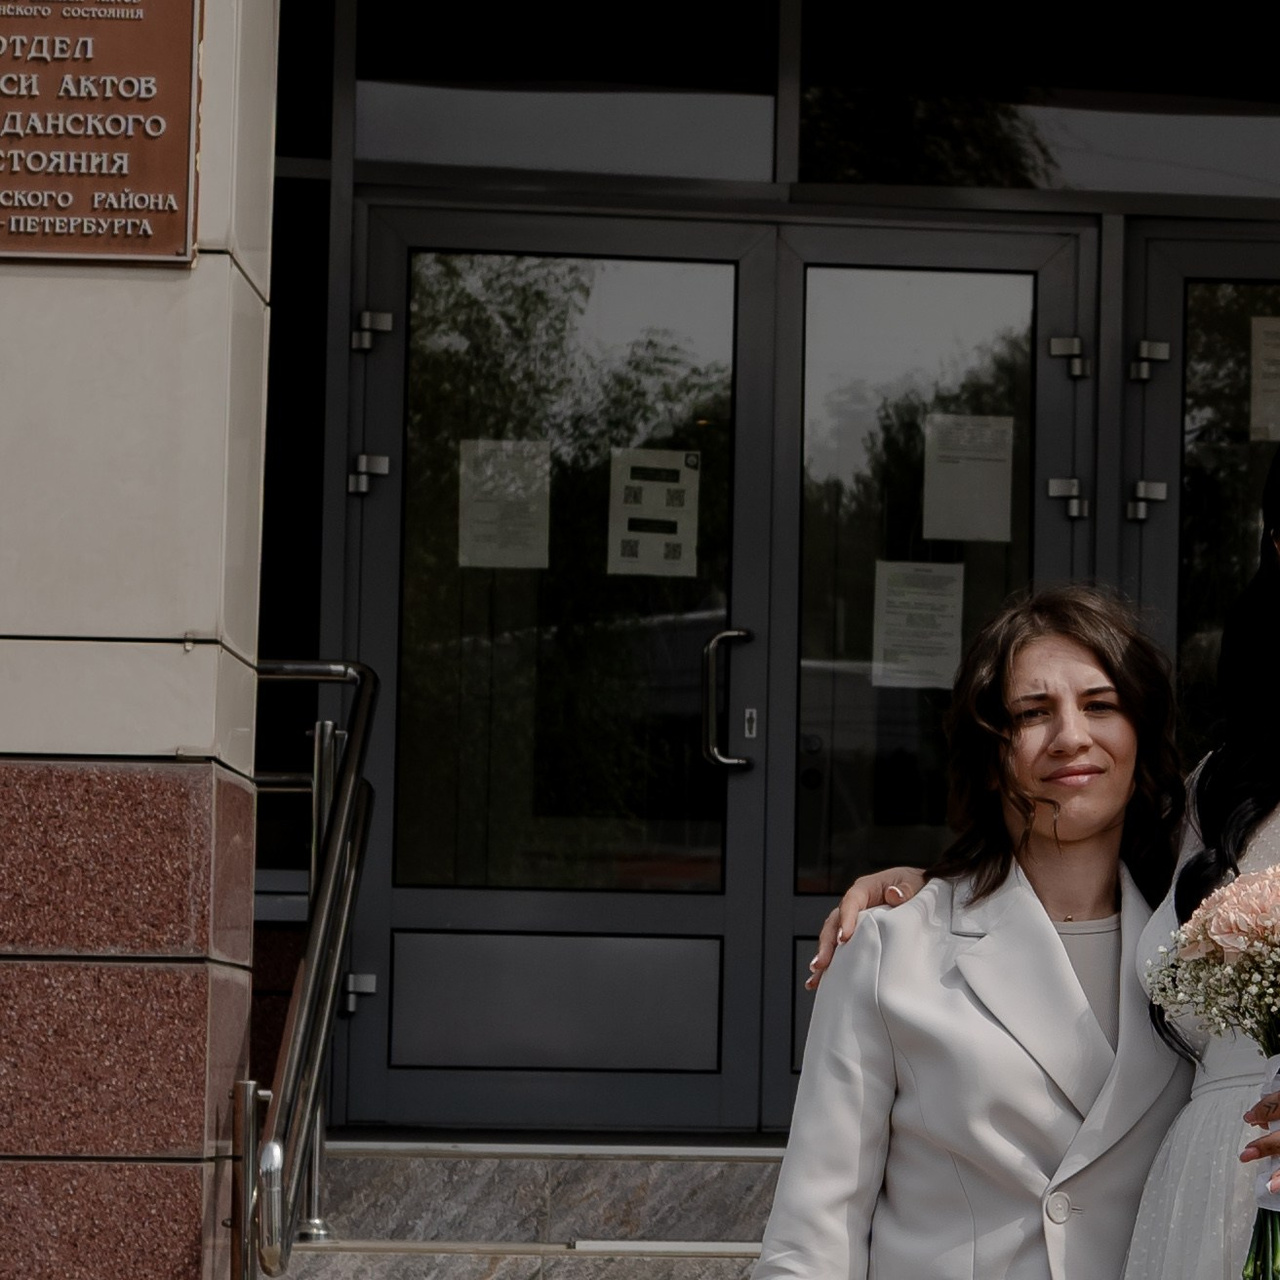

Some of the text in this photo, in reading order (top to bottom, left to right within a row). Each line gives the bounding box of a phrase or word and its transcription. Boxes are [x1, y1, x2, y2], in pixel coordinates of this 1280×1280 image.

[62, 7, 144, 19] СОСТОЯНИЯ
[58, 74, 157, 98] АКТОВ
[0, 149, 130, 175] ТОЯНИЯ
[93, 188, 179, 211] РАЙОНА
